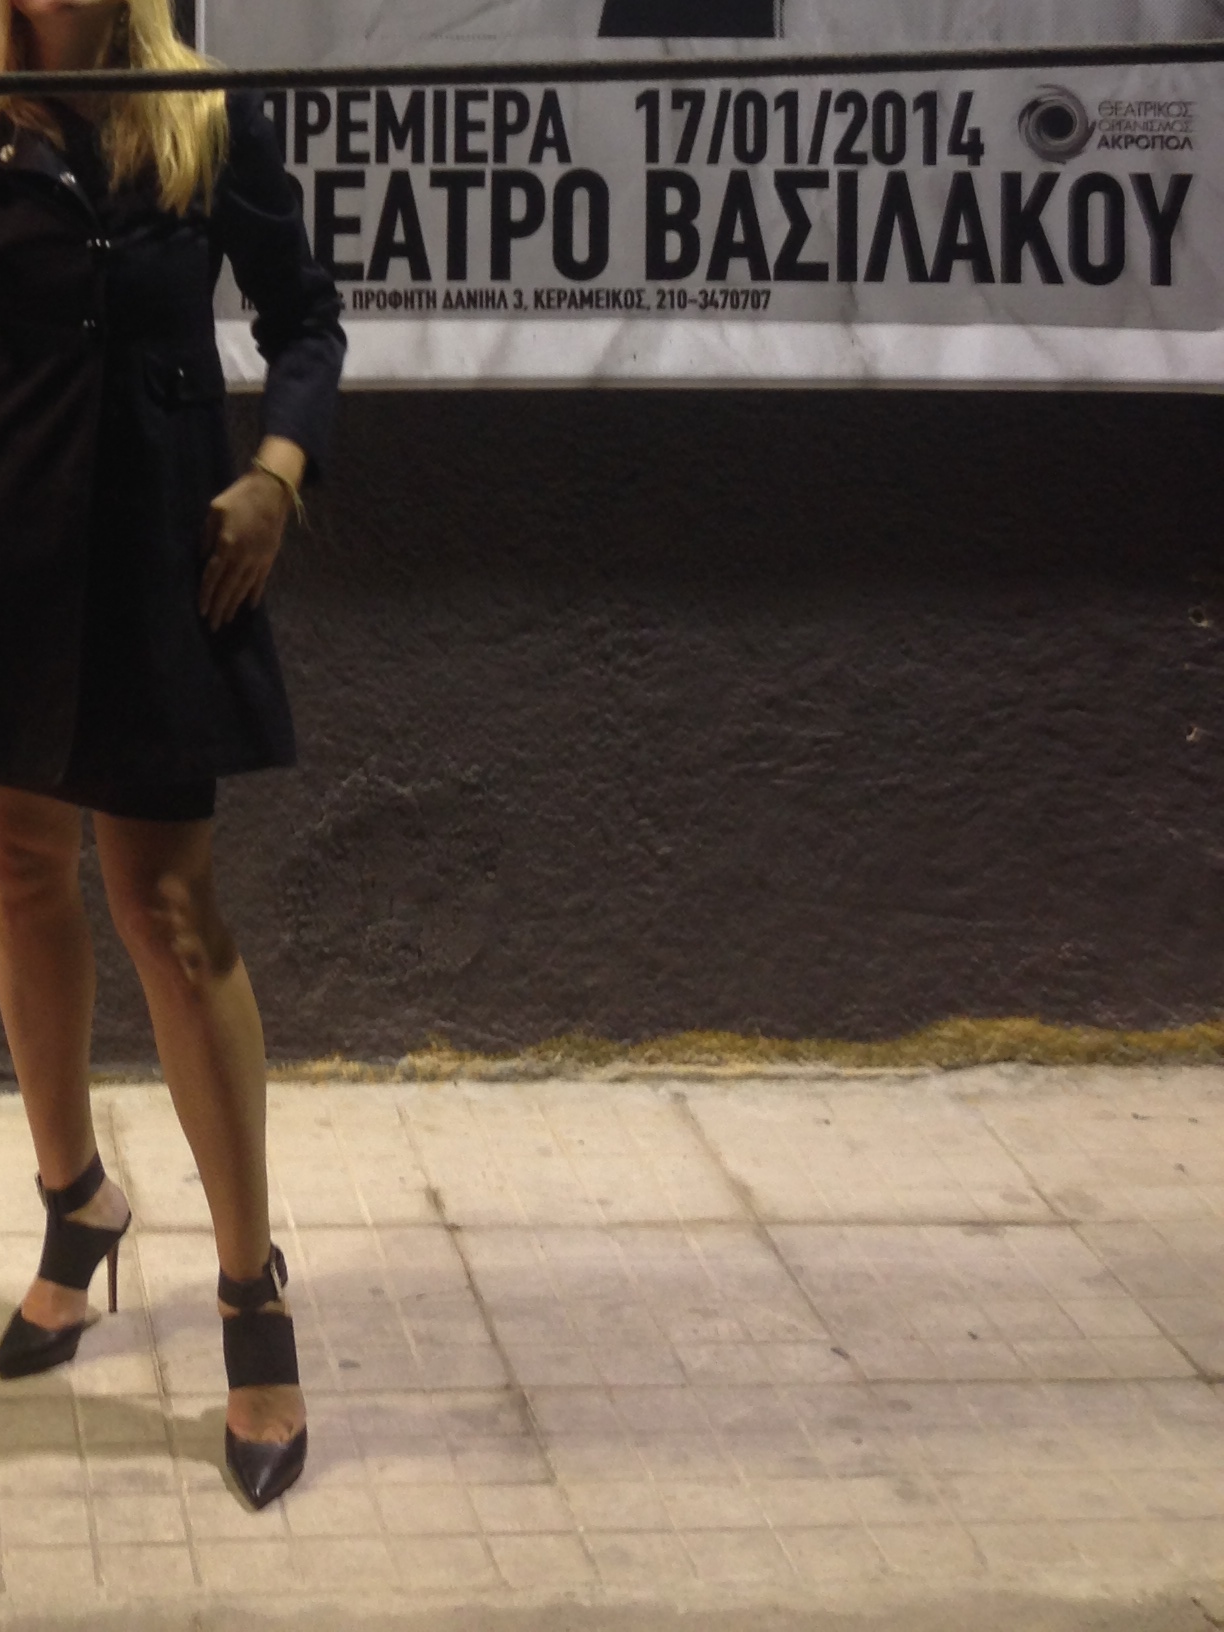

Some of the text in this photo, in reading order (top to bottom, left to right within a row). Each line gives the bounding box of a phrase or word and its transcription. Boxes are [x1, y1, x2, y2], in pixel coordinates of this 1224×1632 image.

[634, 88, 984, 166] 17/01/2014
[1097, 134, 1194, 150] ΑΚΡΟΠΟΛ
[288, 168, 1194, 286] ΕΑΤΡΟ ΒΑΣΙΛΑΚΟΥ
[352, 289, 437, 310] ΠΡΟΦΗΤΗ
[442, 289, 508, 310] ΔΑΝΙΗΛ
[533, 289, 651, 312] ΚΕΡΑΜΕΙΚΟΣ,
[656, 289, 772, 311] 210-3470707
